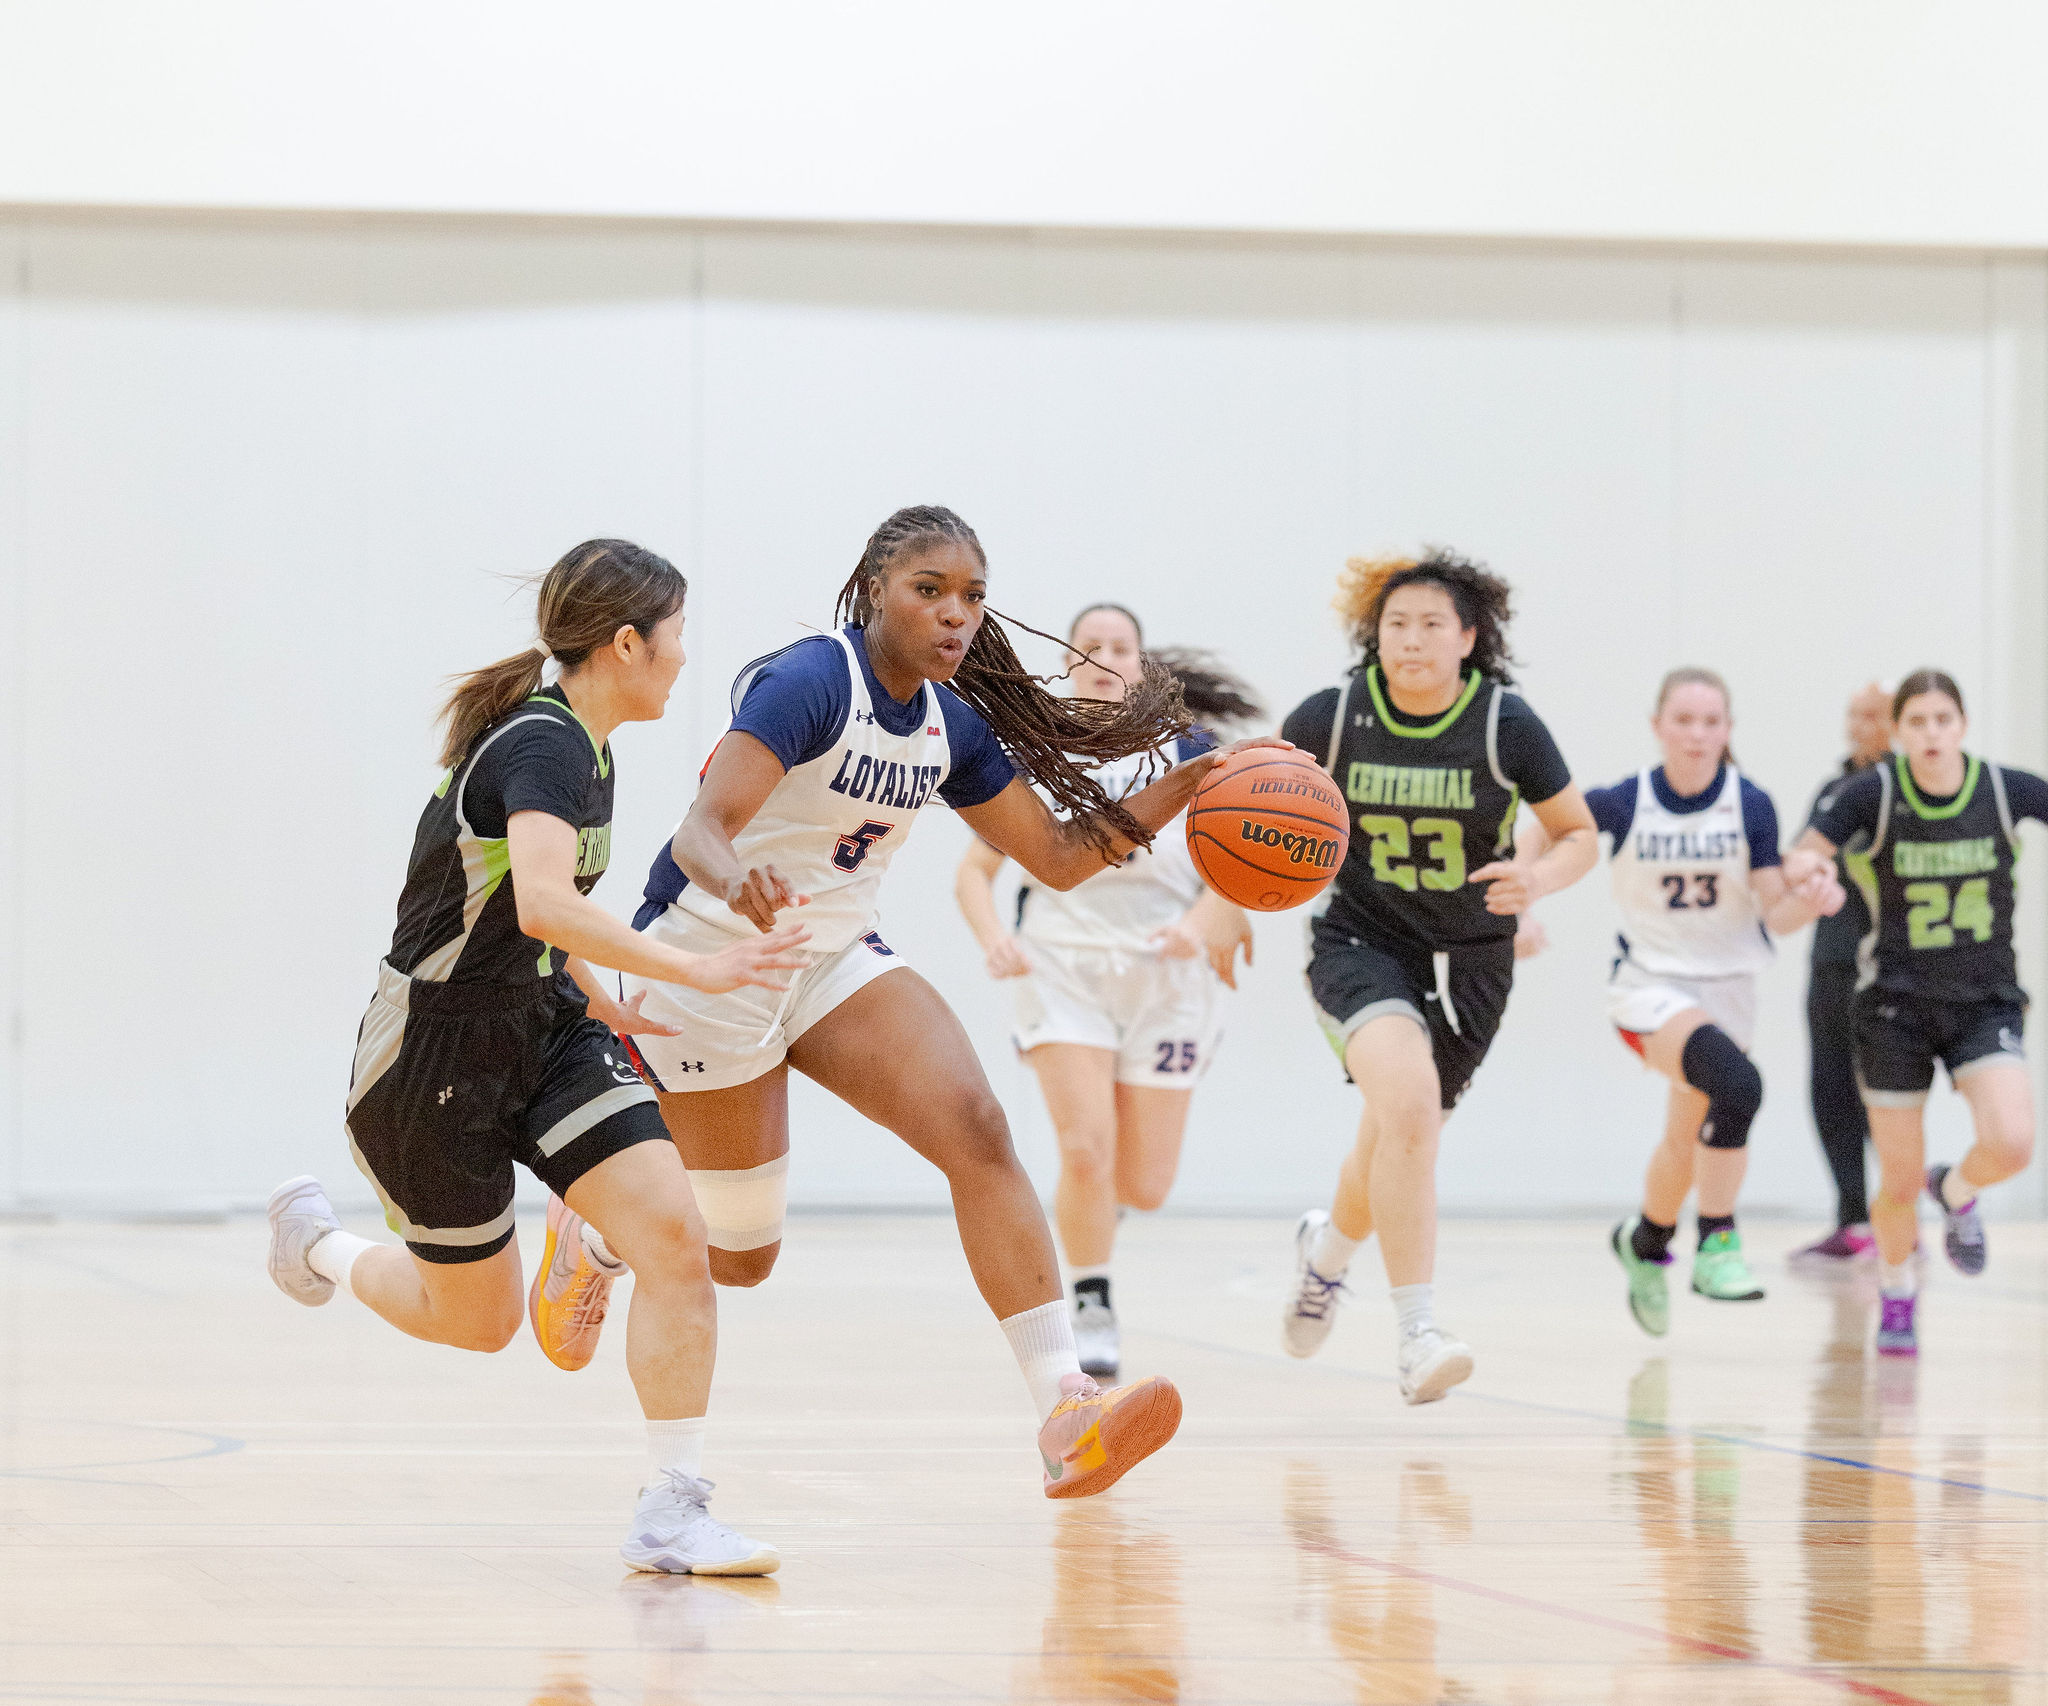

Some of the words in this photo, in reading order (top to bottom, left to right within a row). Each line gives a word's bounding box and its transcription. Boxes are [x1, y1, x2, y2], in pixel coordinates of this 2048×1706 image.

[829, 749, 942, 809] LOYALIST
[1251, 781, 1341, 813] EVOLUTION
[1346, 761, 1476, 810] CENTENNIAL
[831, 819, 895, 873] 5
[1240, 818, 1339, 869] Wilson
[1358, 813, 1467, 892] 23
[1661, 874, 1720, 909] 23
[1903, 878, 1995, 950] 24
[1155, 1040, 1197, 1073] 25
